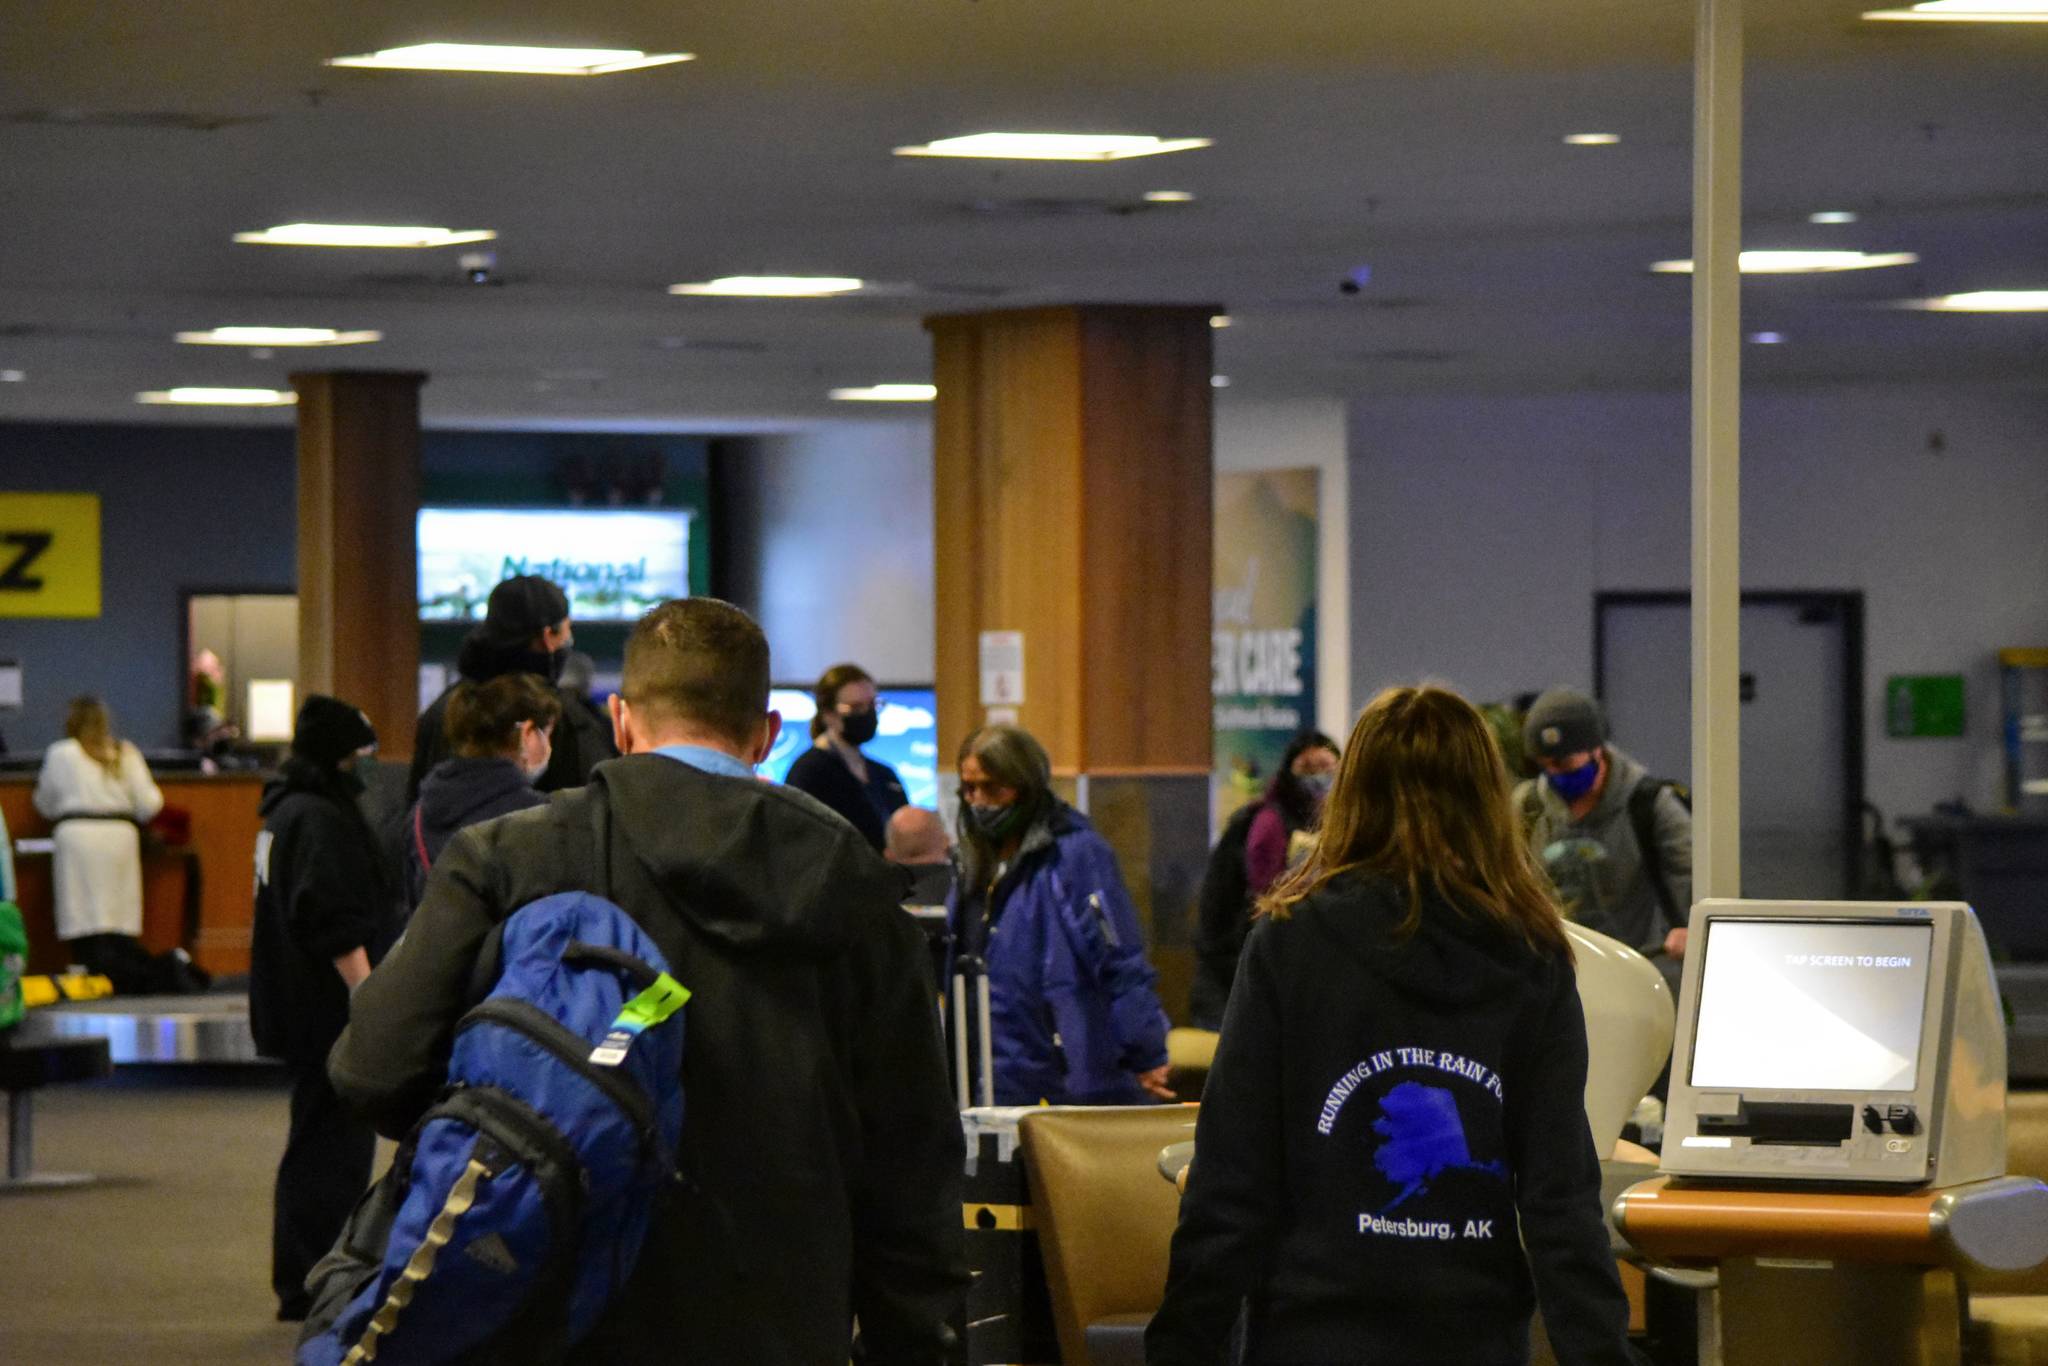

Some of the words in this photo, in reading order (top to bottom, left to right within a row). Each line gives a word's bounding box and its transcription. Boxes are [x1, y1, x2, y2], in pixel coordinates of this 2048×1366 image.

[502, 554, 647, 582] National
[1241, 628, 1303, 695] CARE
[1784, 954, 1808, 967] TAP
[1809, 954, 1854, 967] SCREEN
[1856, 956, 1873, 968] TO
[1875, 956, 1912, 968] BEGIN
[1317, 1061, 1372, 1136] RUNNING
[1370, 1051, 1394, 1072] IN
[1397, 1047, 1435, 1067] THE
[1439, 1052, 1488, 1083] RAIN
[1485, 1073, 1503, 1104] FO
[1358, 1213, 1456, 1240] Petersburg,
[1463, 1220, 1494, 1239] AK
